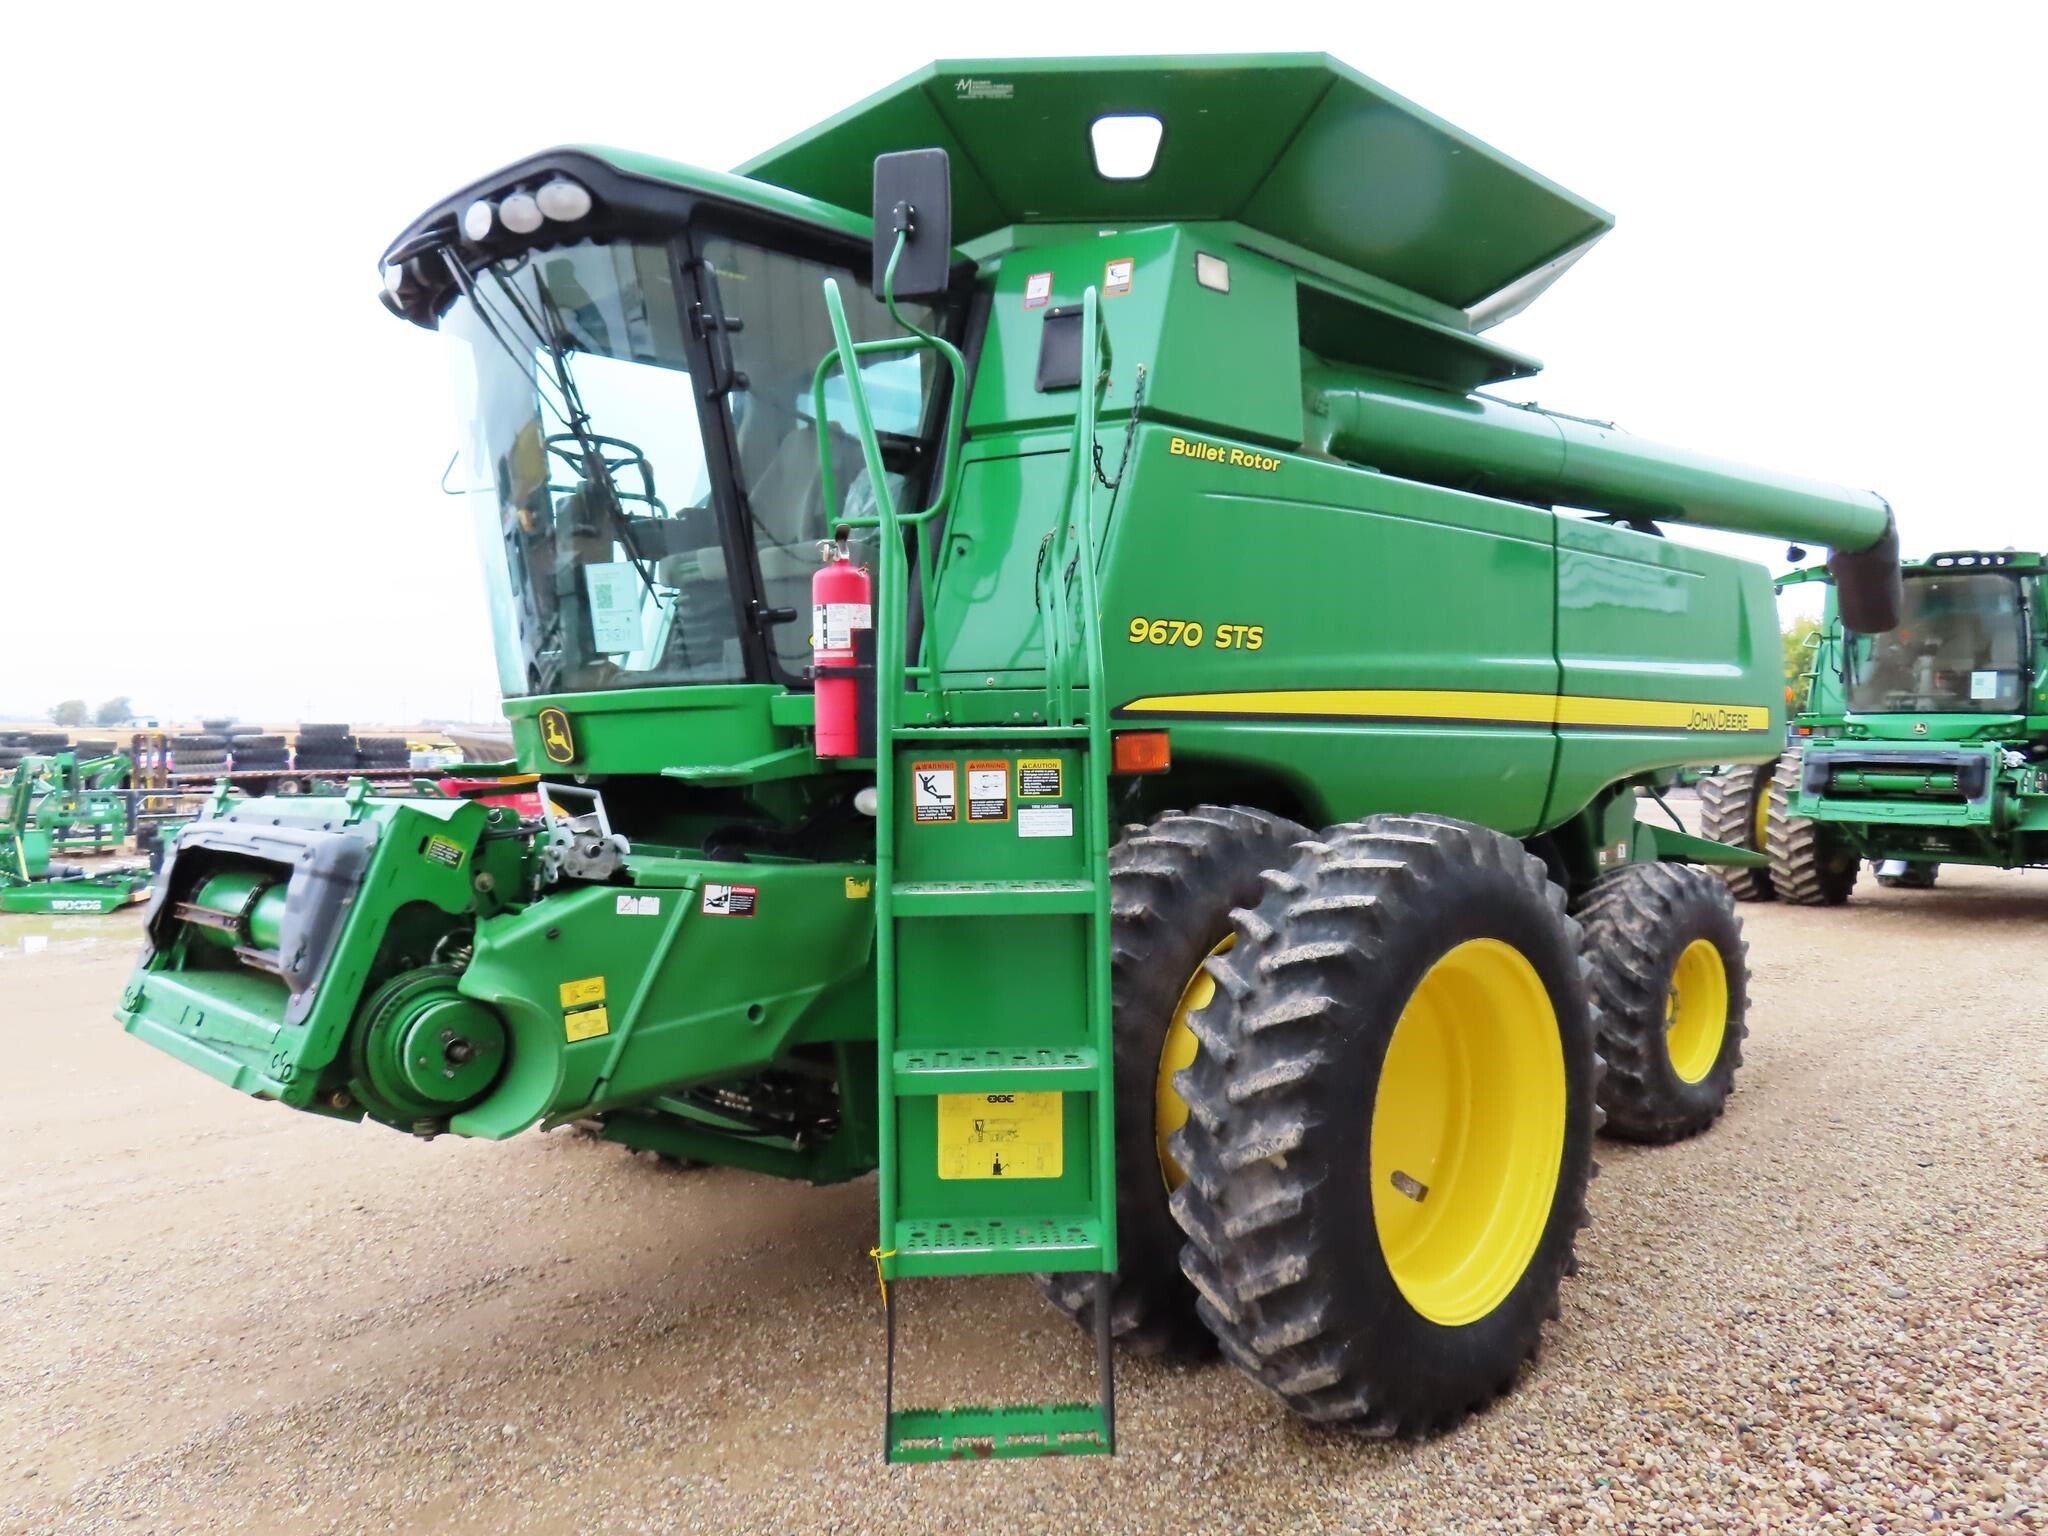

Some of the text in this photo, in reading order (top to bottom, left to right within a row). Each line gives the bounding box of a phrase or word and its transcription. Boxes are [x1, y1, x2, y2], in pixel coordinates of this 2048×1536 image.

[1170, 437, 1281, 472] Bullet Rotor
[1128, 616, 1264, 650] 9670 STS
[1687, 707, 1749, 729] JOHN DEERE
[51, 900, 102, 910] WOODS
